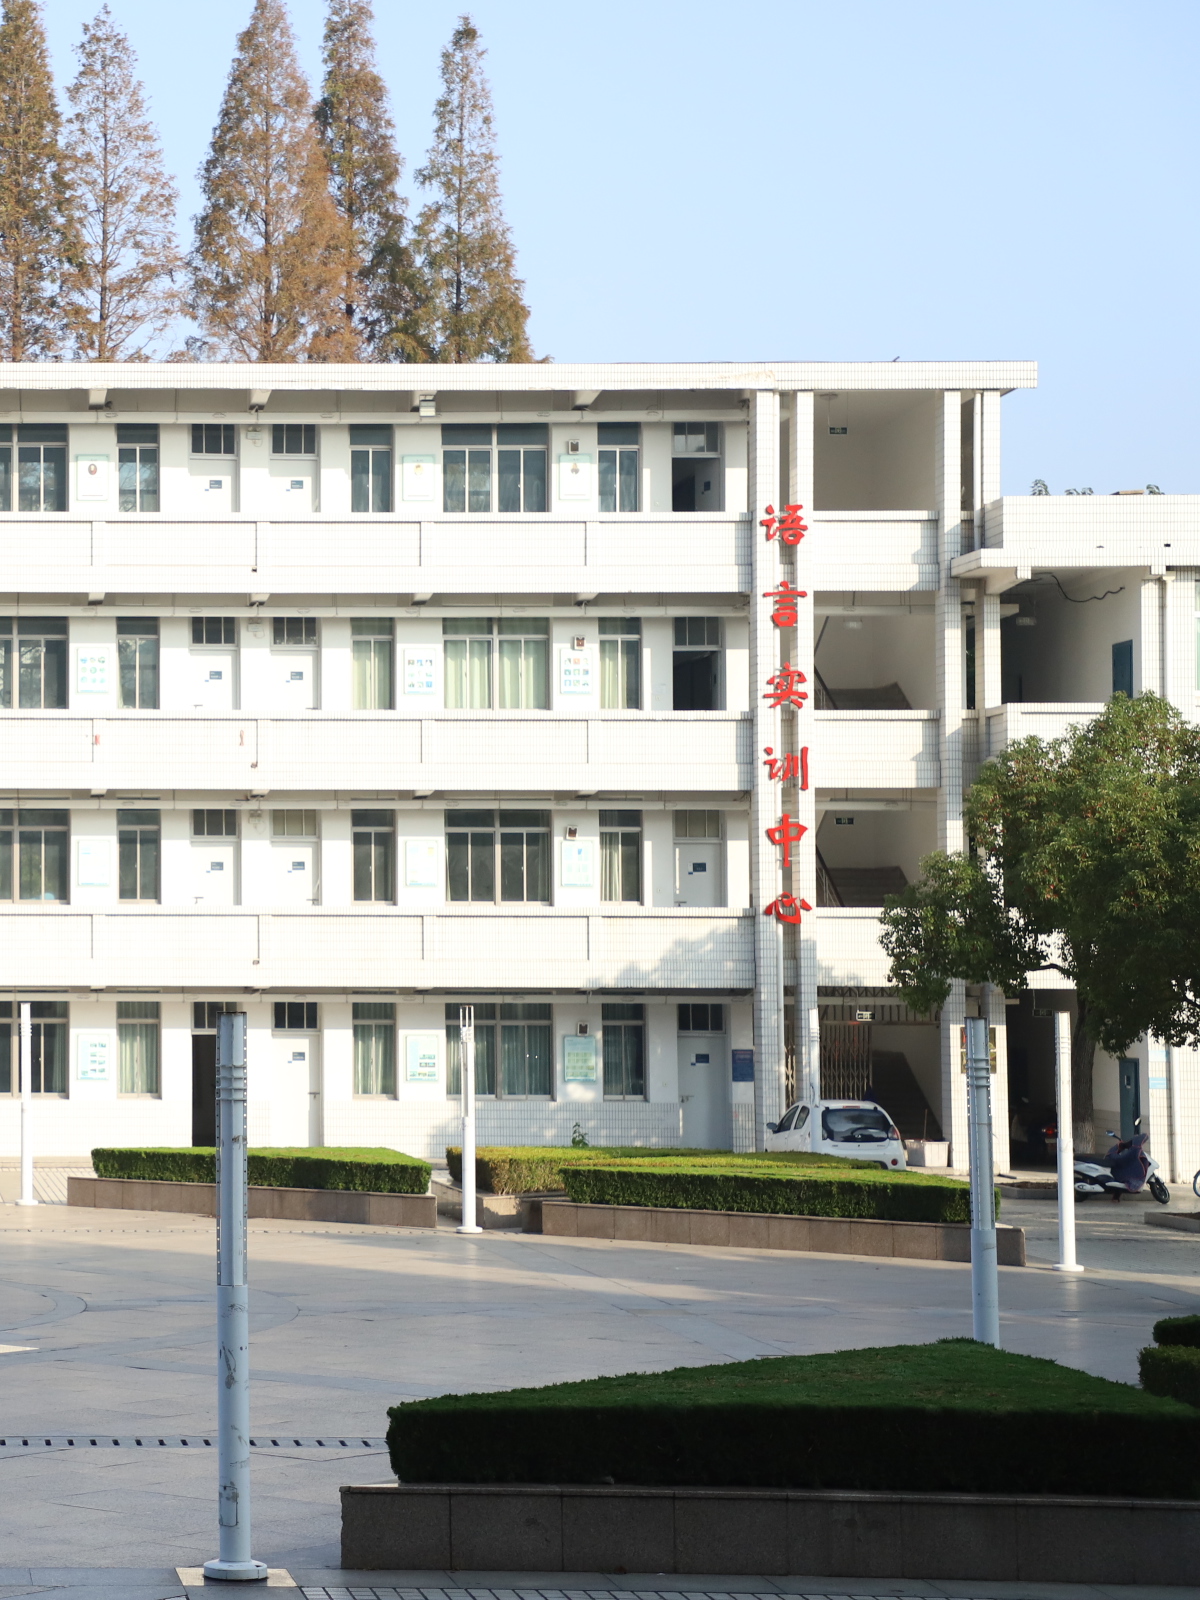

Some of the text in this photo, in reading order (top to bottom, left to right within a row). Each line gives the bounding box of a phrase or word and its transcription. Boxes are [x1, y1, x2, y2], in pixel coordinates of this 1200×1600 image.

[760, 504, 811, 924] 语言实训中心
